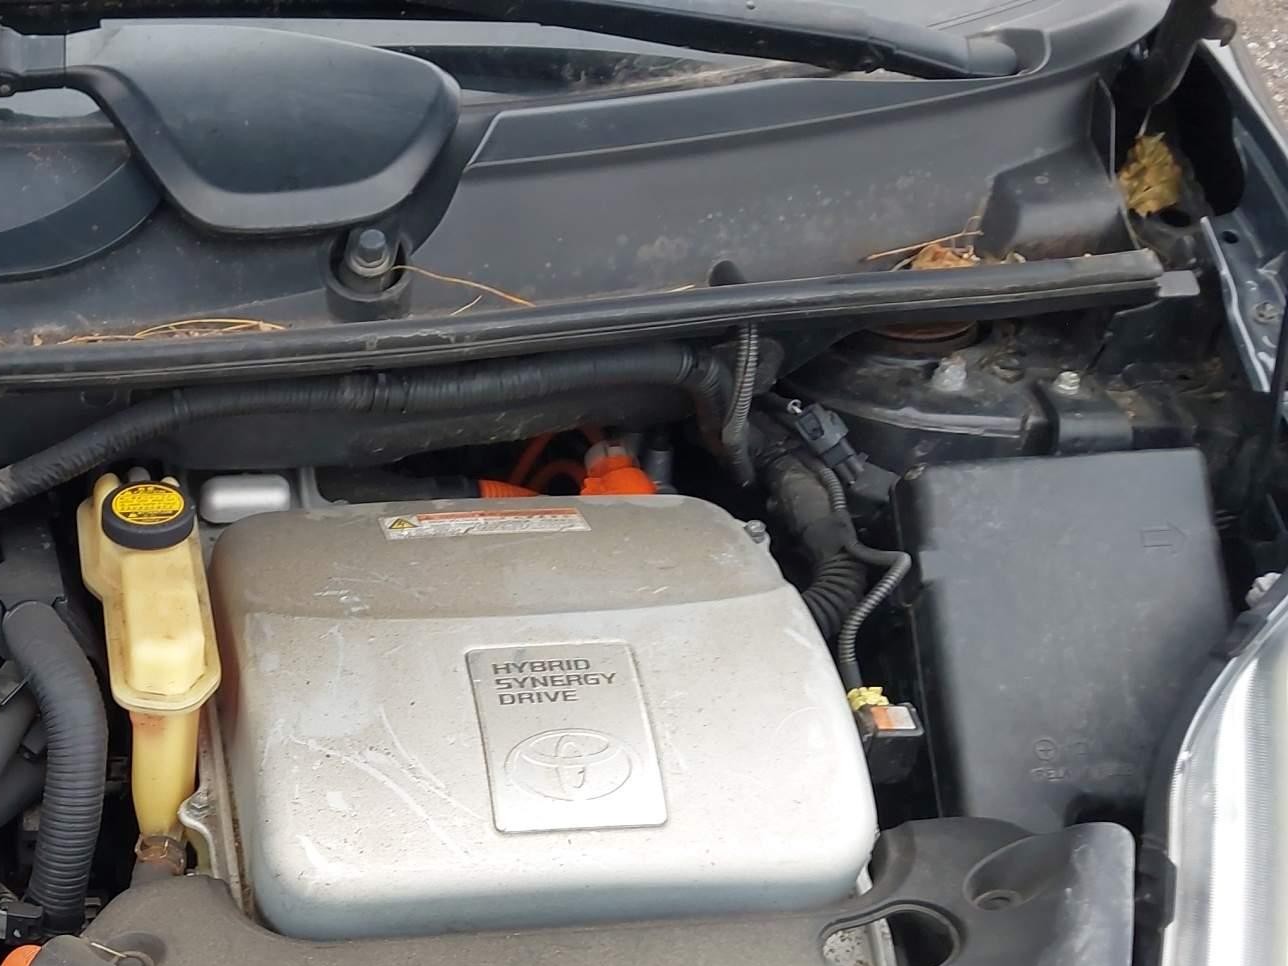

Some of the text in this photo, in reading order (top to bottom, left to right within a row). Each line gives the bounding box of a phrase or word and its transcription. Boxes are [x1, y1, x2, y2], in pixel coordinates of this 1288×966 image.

[491, 659, 591, 675] HYBRID
[494, 672, 617, 690] SYNERGY
[497, 689, 579, 706] DRIVE
